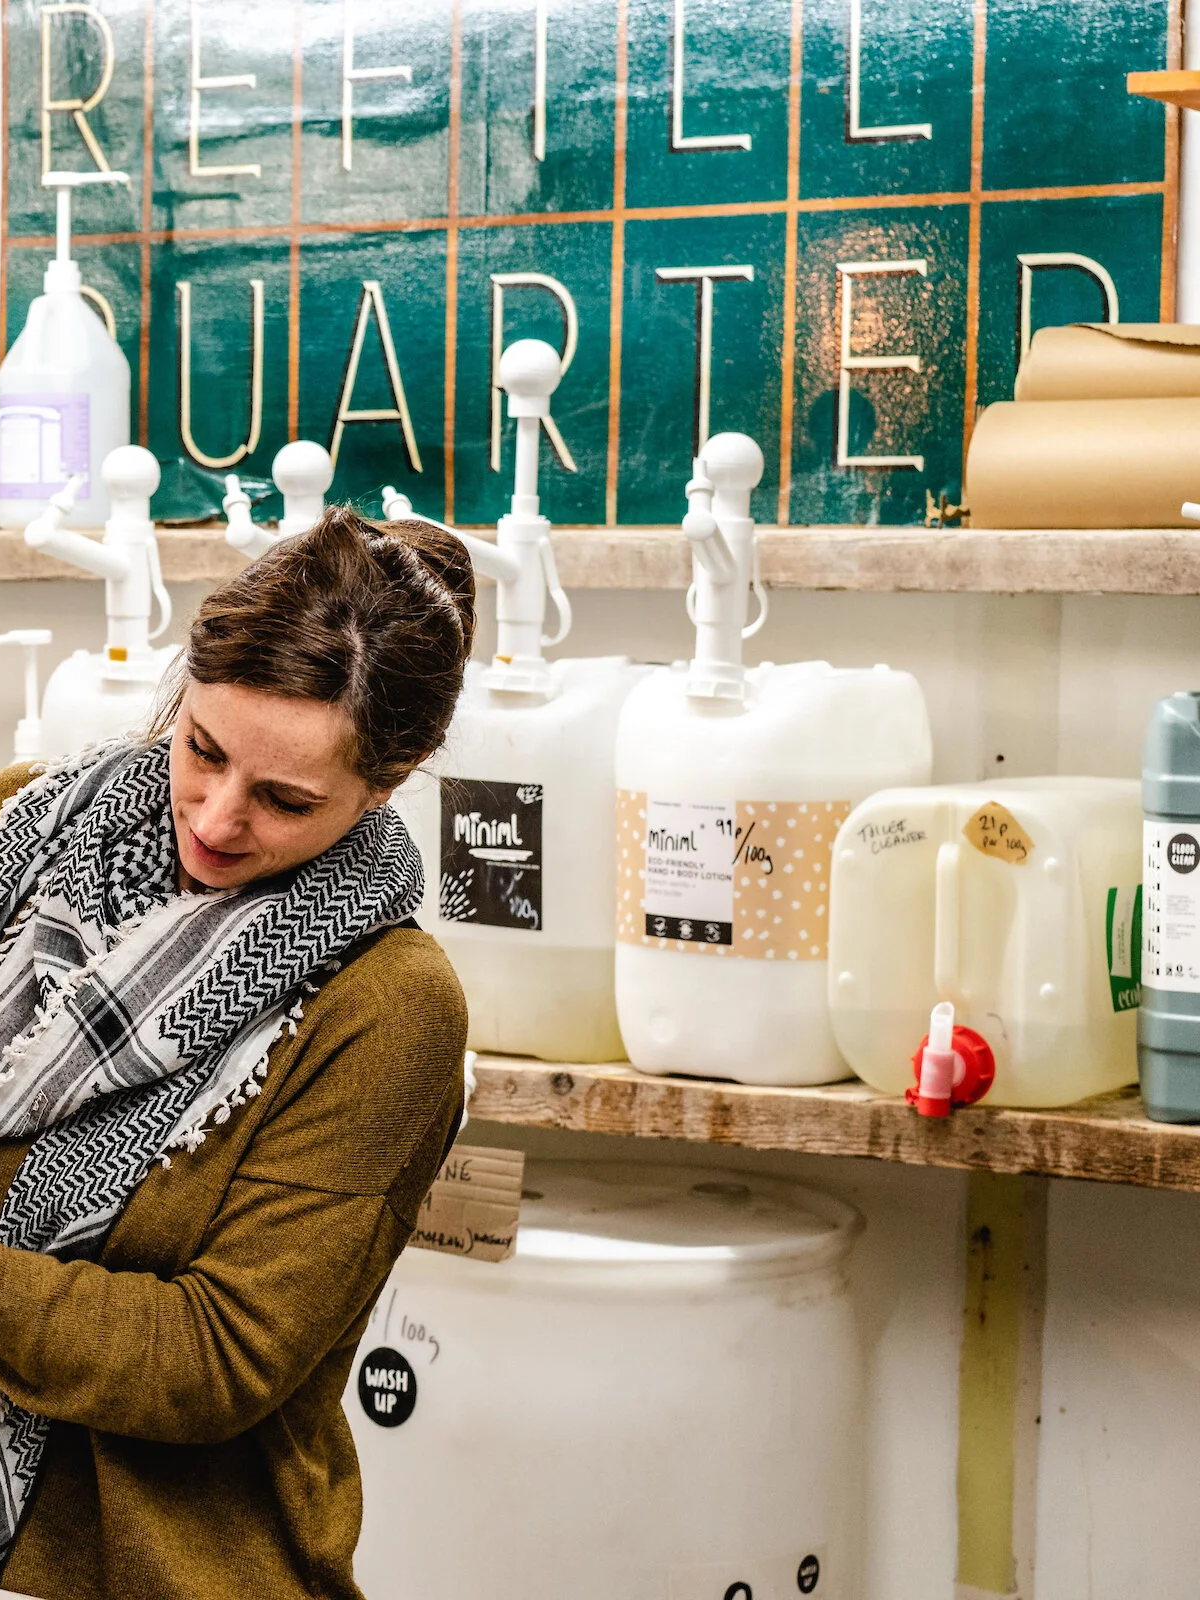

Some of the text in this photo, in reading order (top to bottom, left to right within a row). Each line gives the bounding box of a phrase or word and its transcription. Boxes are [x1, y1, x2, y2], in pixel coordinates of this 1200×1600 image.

[40, 0, 933, 192] REFILL
[81, 252, 1119, 476] UARTE
[871, 831, 928, 855] CLEANER
[365, 1366, 409, 1393] WASH
[374, 1391, 398, 1414] UP
